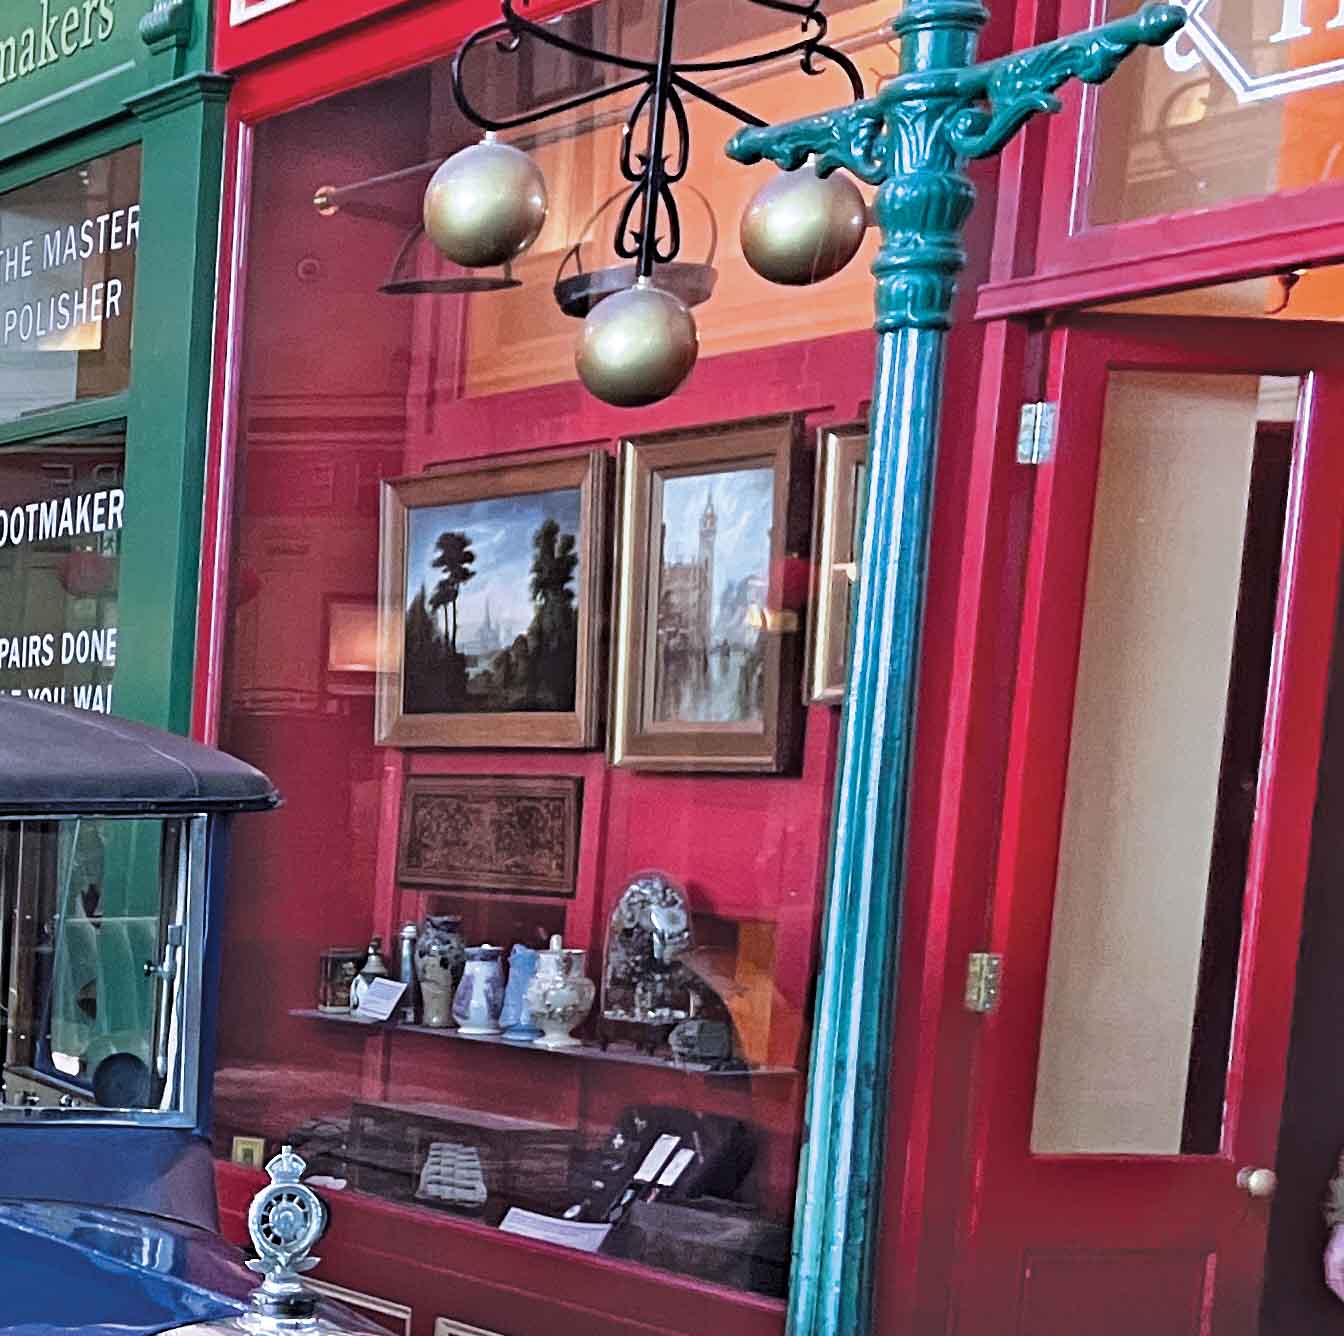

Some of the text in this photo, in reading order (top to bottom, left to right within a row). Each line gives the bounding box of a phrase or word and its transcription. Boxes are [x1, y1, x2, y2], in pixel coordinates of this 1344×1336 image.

[42, 204, 141, 272] MASTER
[4, 278, 123, 346] POLISHER
[61, 628, 119, 668] DONE
